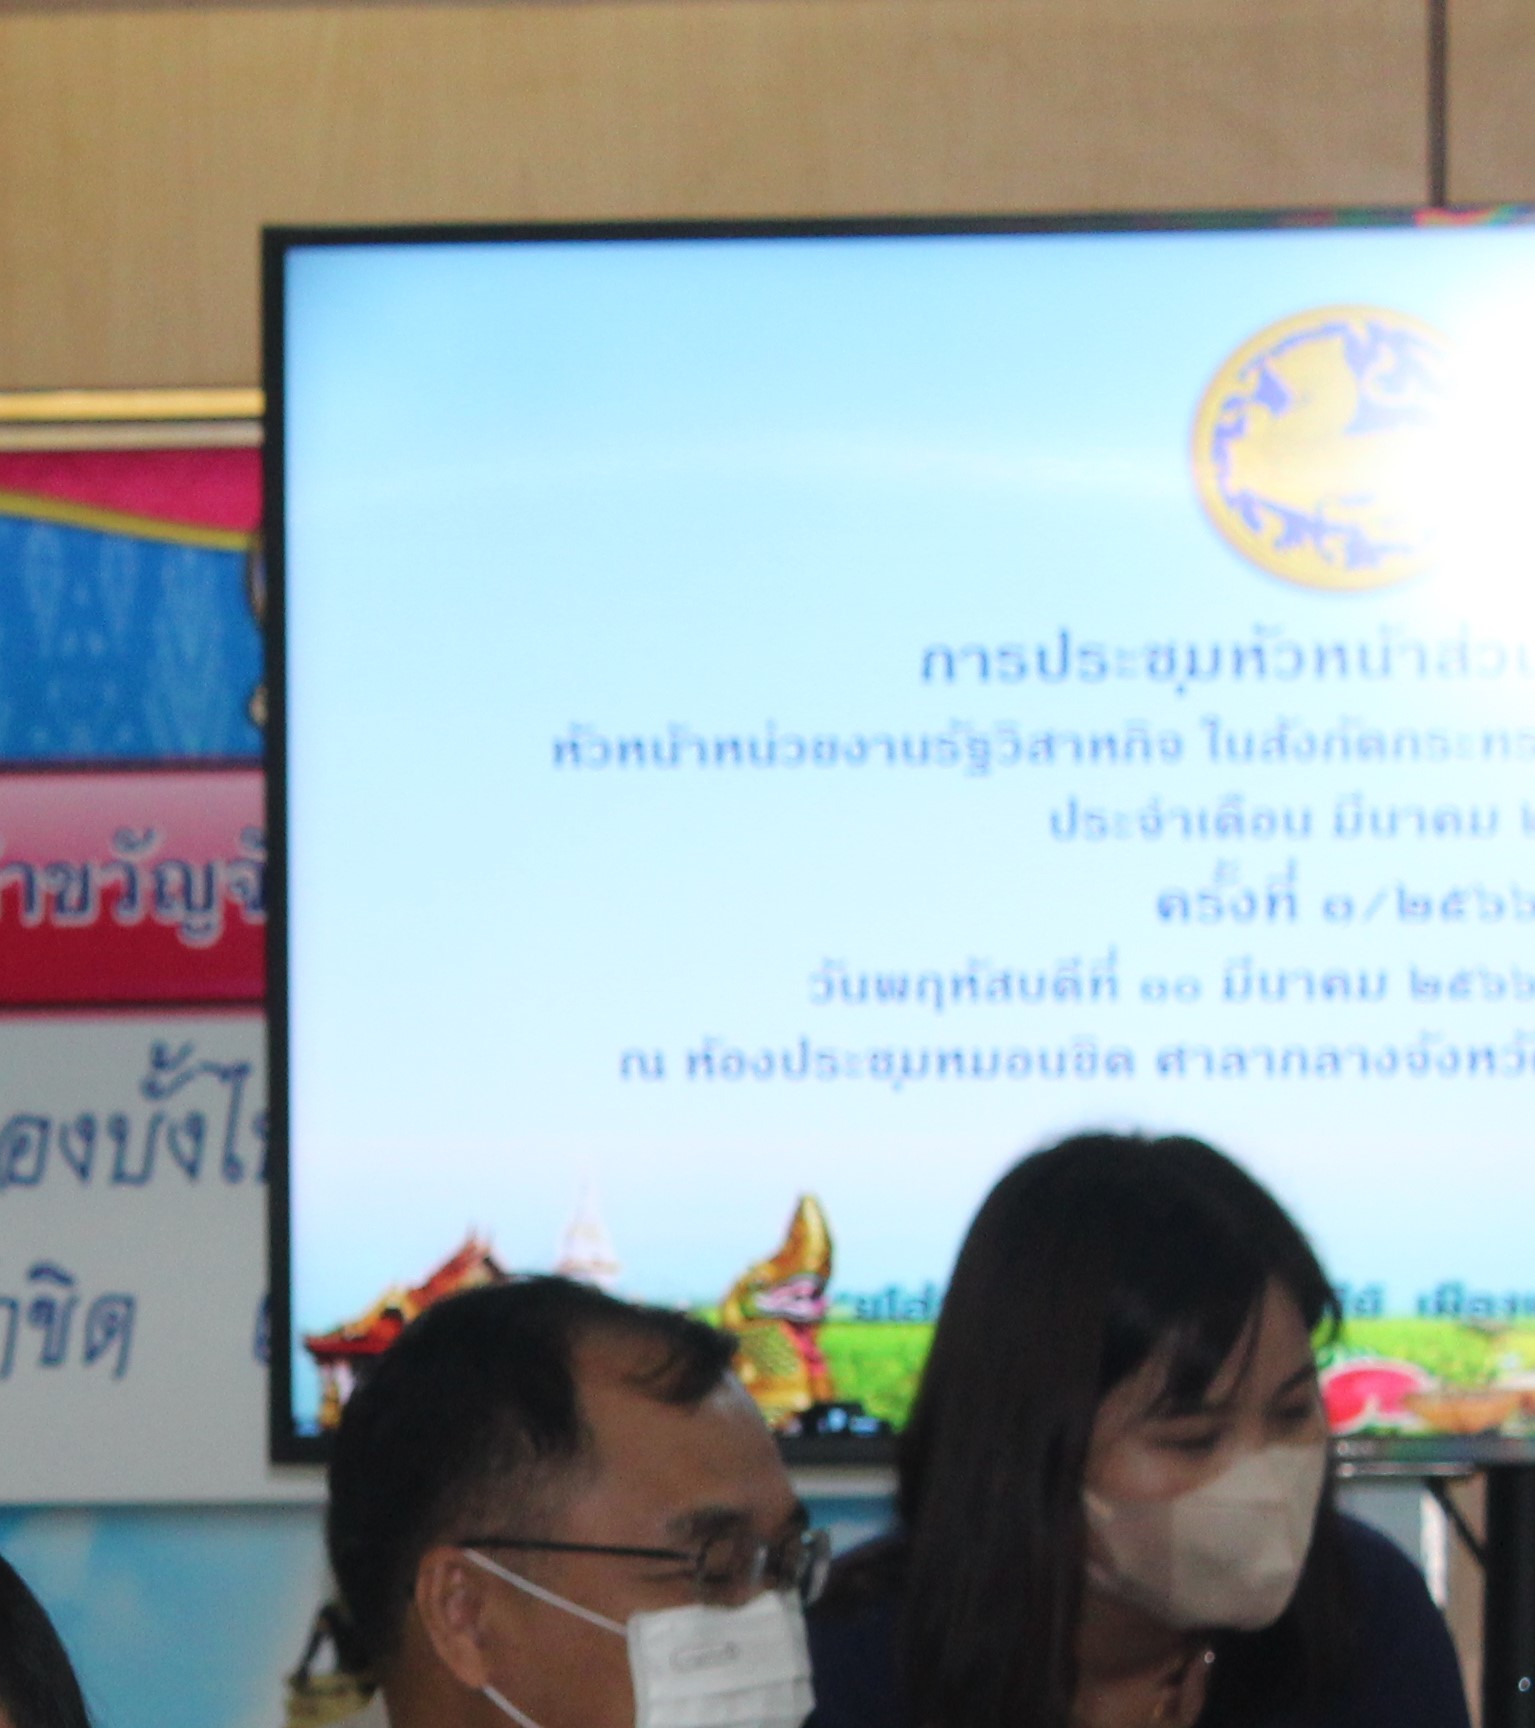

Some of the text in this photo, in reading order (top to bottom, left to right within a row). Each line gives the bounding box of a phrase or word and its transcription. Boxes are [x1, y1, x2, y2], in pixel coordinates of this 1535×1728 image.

[551, 718, 1185, 777] หัวหน้าหน่วยงานรัฐวิสาหกิจ
[1048, 789, 1314, 841] ประจำเดือน
[1332, 787, 1500, 841] มีนาคม
[1155, 856, 1298, 924] ครั้งที่
[808, 943, 1120, 1012] วันพฤหัสบดีที่
[1221, 954, 1388, 1003] มีนาคม
[618, 1028, 1535, 1091] ณ ห้องประชุมหมอนขิด ศาลากลางจังหวั
